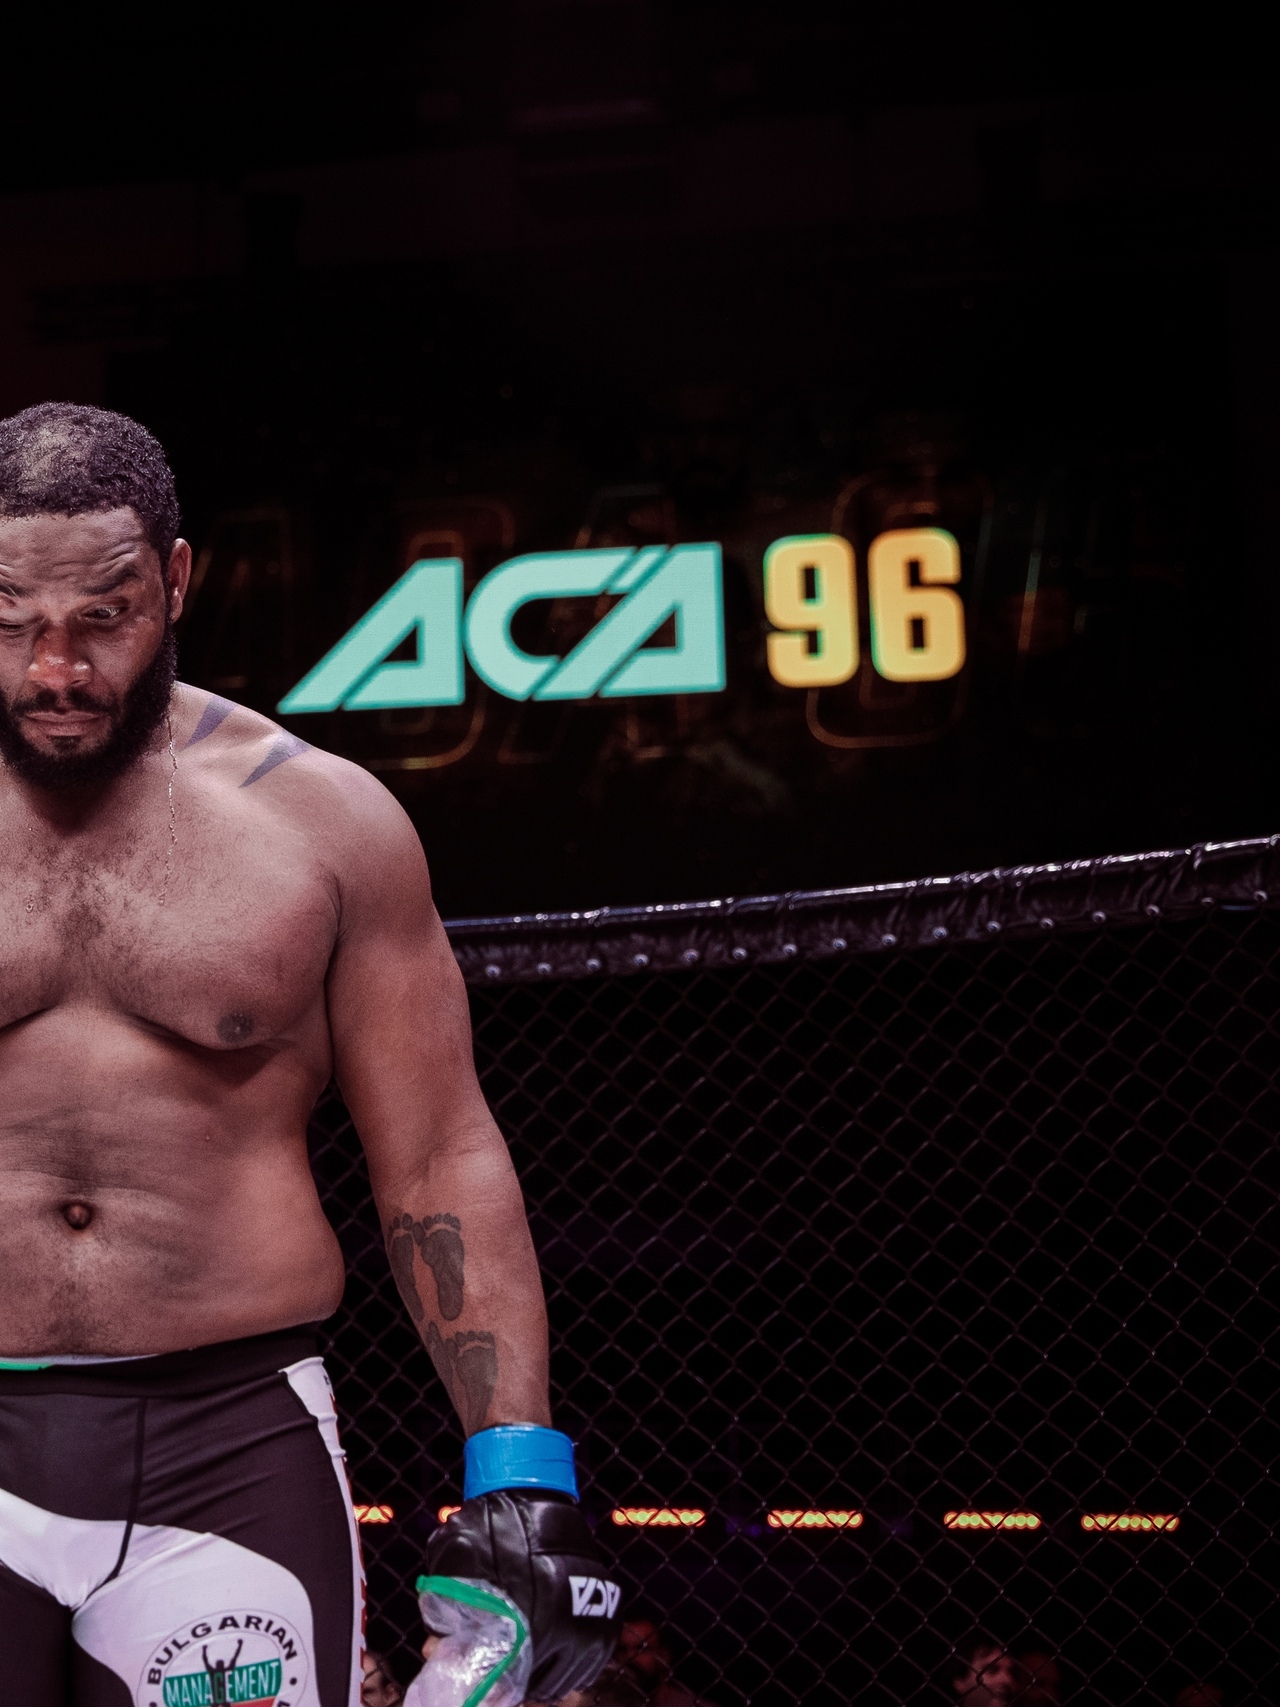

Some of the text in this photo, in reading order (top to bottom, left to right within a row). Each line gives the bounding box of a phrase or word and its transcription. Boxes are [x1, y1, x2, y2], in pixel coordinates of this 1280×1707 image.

[276, 541, 727, 715] ACA
[763, 526, 967, 689] 96
[147, 1614, 298, 1685] BULGARIAN
[165, 1661, 280, 1707] MANAGEMENT
